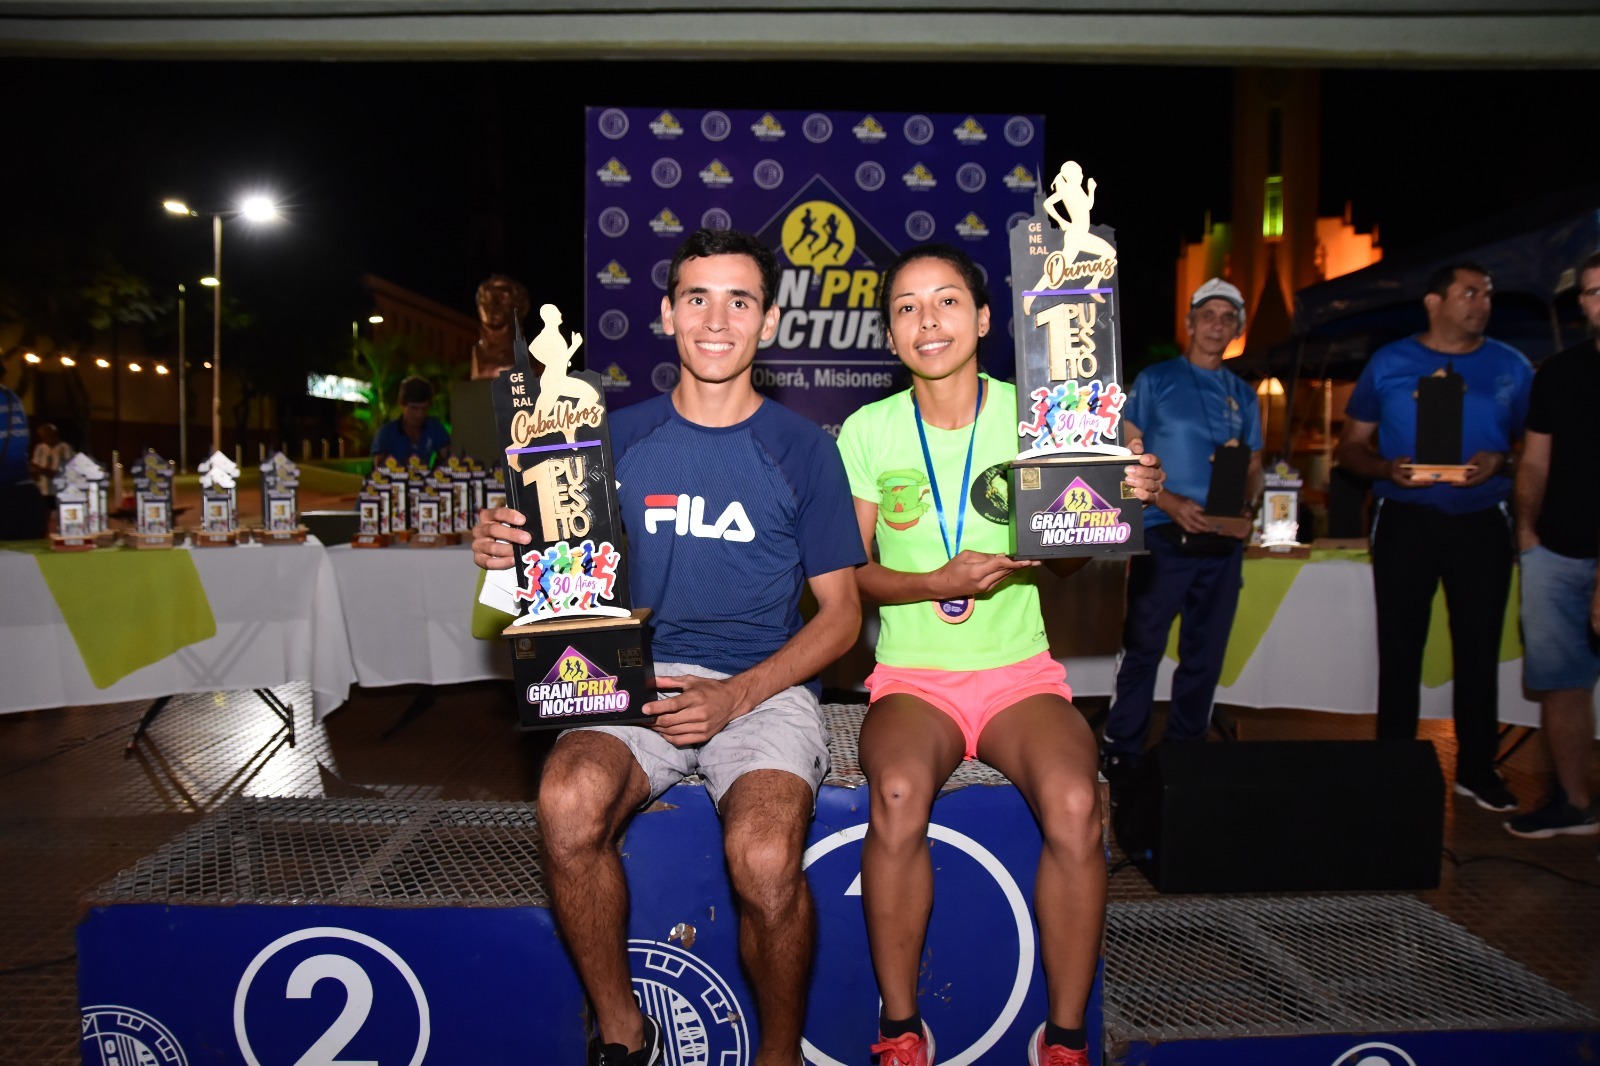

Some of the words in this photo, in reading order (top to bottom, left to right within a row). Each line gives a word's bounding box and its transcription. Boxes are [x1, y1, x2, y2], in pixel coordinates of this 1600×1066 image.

[1028, 222, 1042, 232] GE
[1028, 234, 1043, 244] NE
[1029, 246, 1050, 255] RAL
[1046, 253, 1116, 287] Damas
[510, 372, 525, 383] GE
[814, 368, 893, 388] Misiones
[511, 385, 526, 395] NE
[513, 397, 534, 408] RAL
[514, 404, 601, 444] Caballeros
[1056, 413, 1075, 431] 30
[1078, 413, 1101, 430] Años
[644, 493, 756, 543] FILA
[1031, 512, 1076, 530] GRAN
[1079, 510, 1118, 528] PRIX
[1042, 526, 1127, 545] NOCTURNO
[552, 576, 571, 596] 30
[575, 575, 598, 592] Años
[528, 683, 573, 701] GRAN
[576, 678, 616, 697] PRIX
[541, 693, 628, 716] NOCTURNO
[286, 953, 378, 1066] 2
